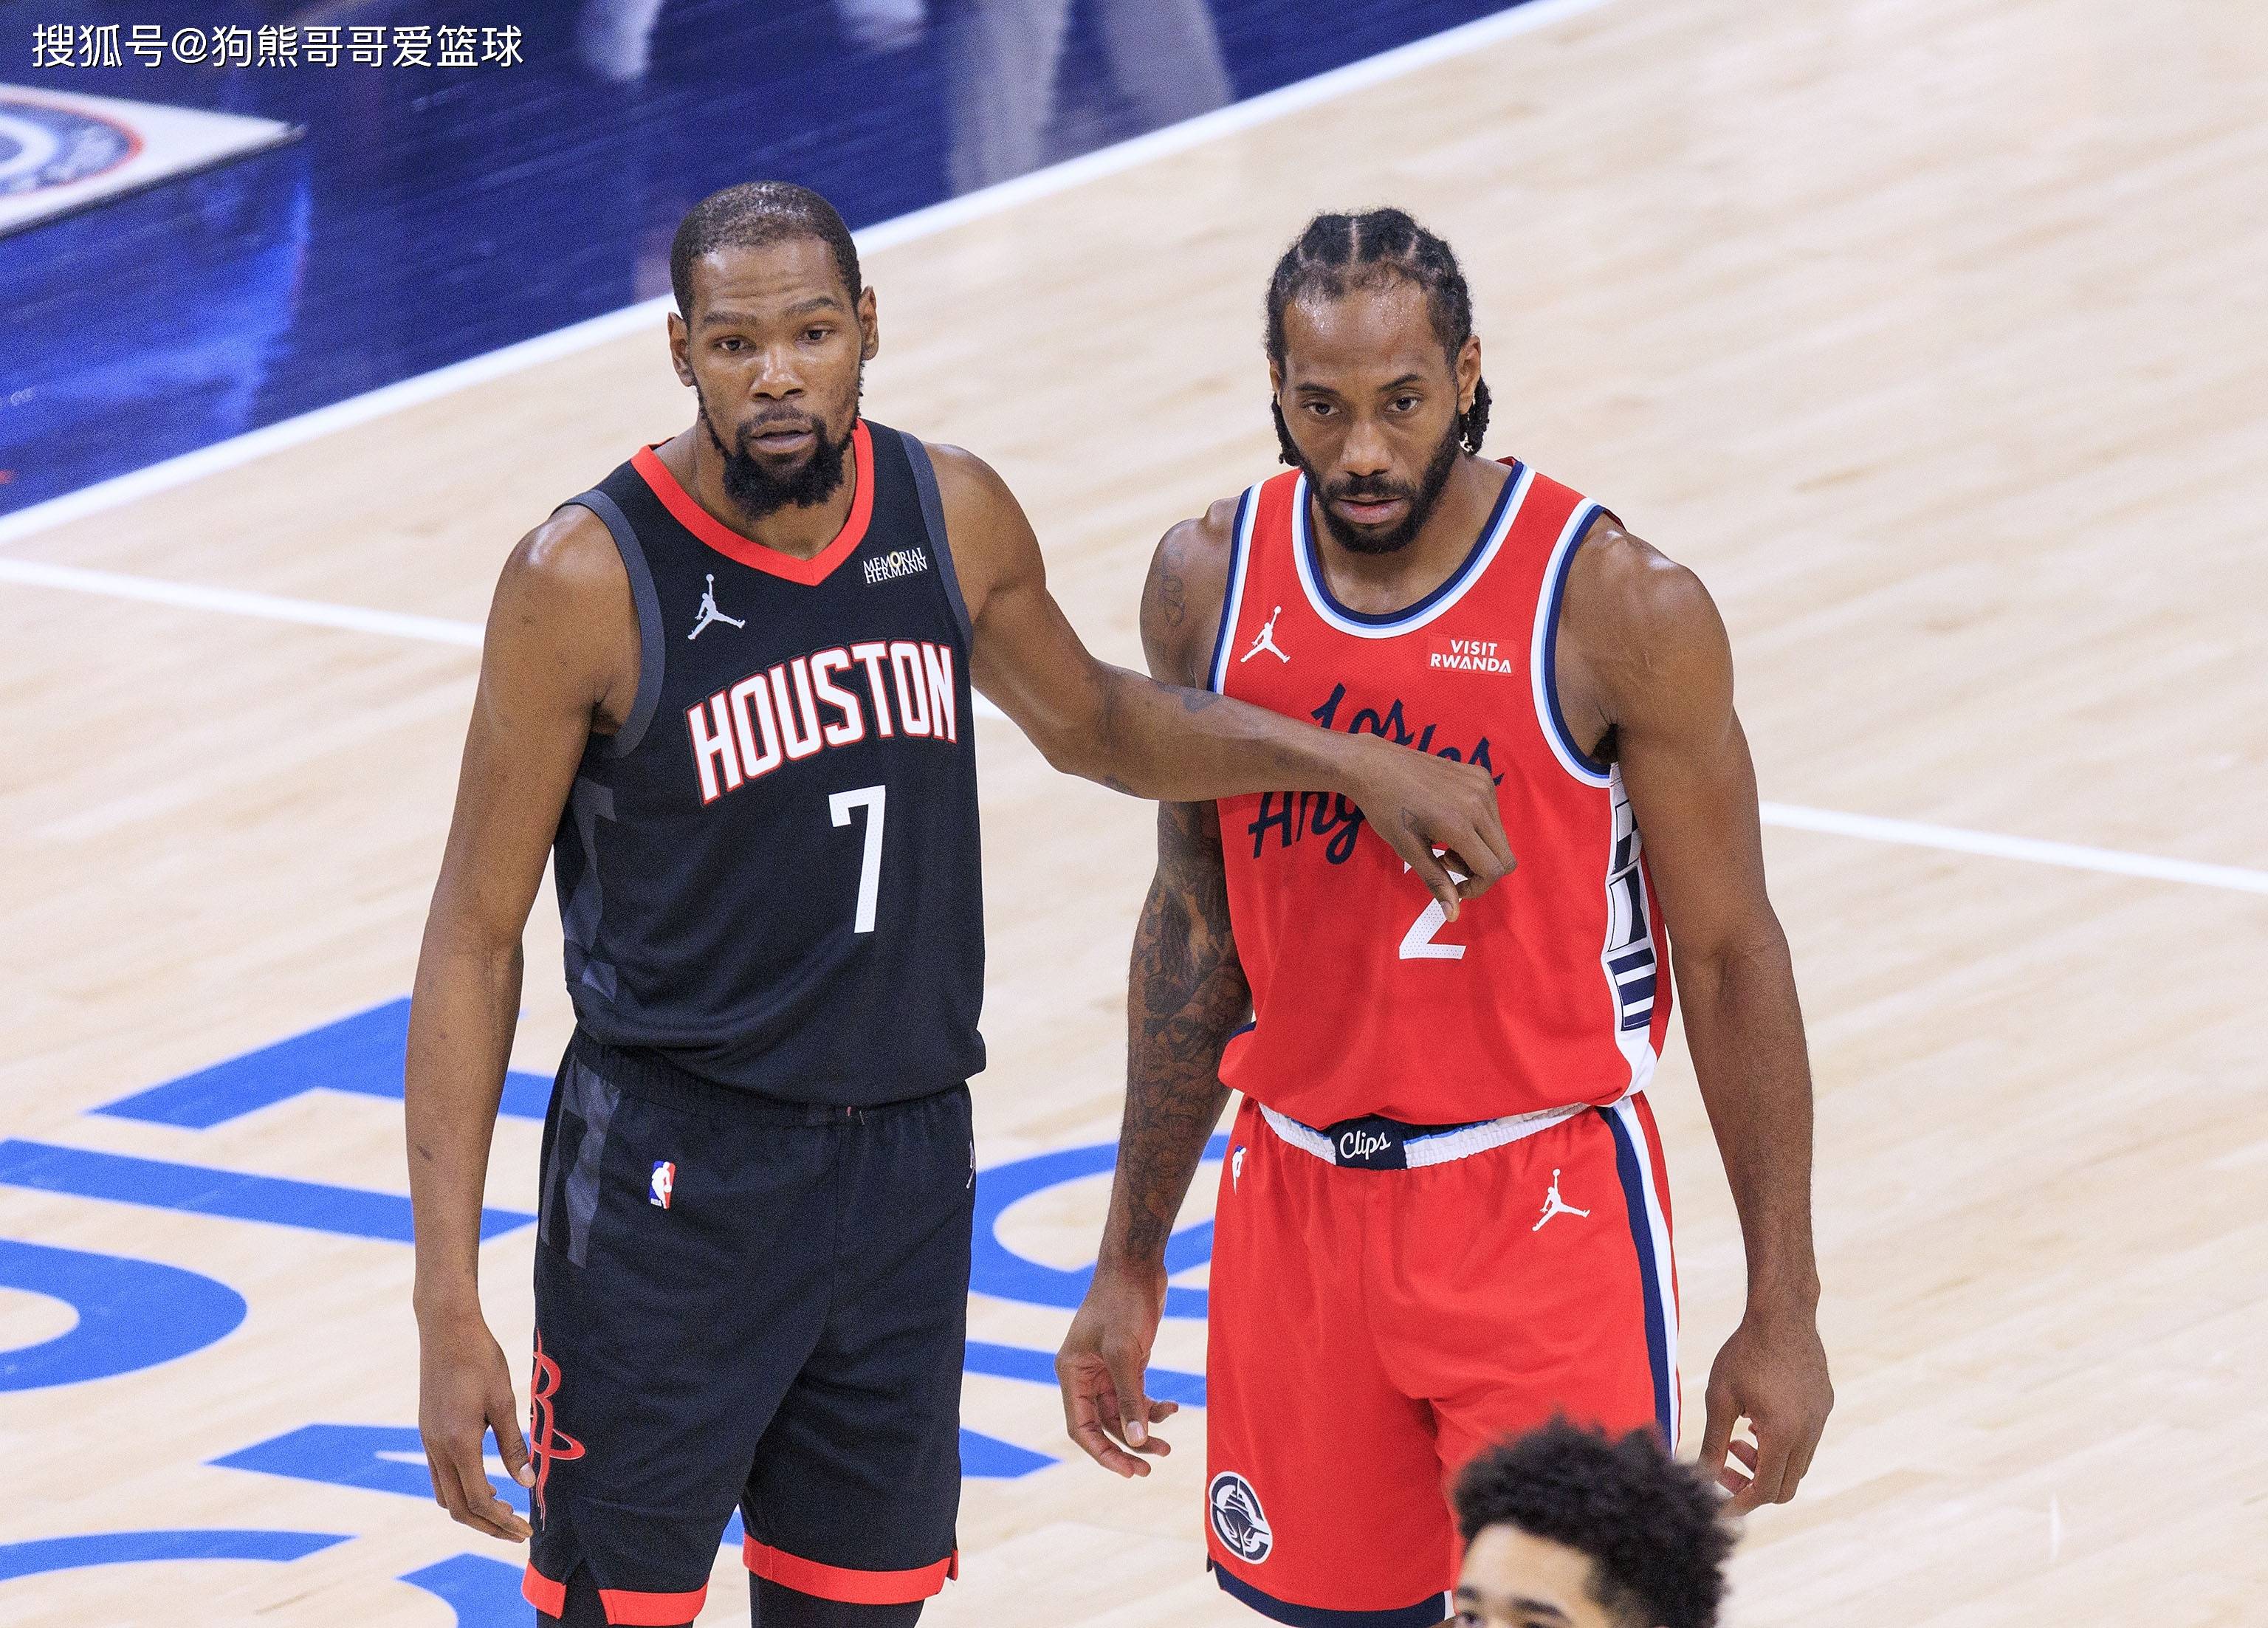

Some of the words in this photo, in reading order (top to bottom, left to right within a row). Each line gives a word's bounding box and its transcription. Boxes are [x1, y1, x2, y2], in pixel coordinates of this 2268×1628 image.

[863, 547, 926, 572] MEMORIAL
[865, 557, 928, 584] HERMANN
[1451, 639, 1498, 656] VISIT
[1430, 653, 1512, 673] RWANDA
[686, 640, 956, 806] HOUSTON
[828, 784, 886, 934] 7
[1398, 848, 1469, 960] 2
[1339, 1130, 1392, 1161] Clips
